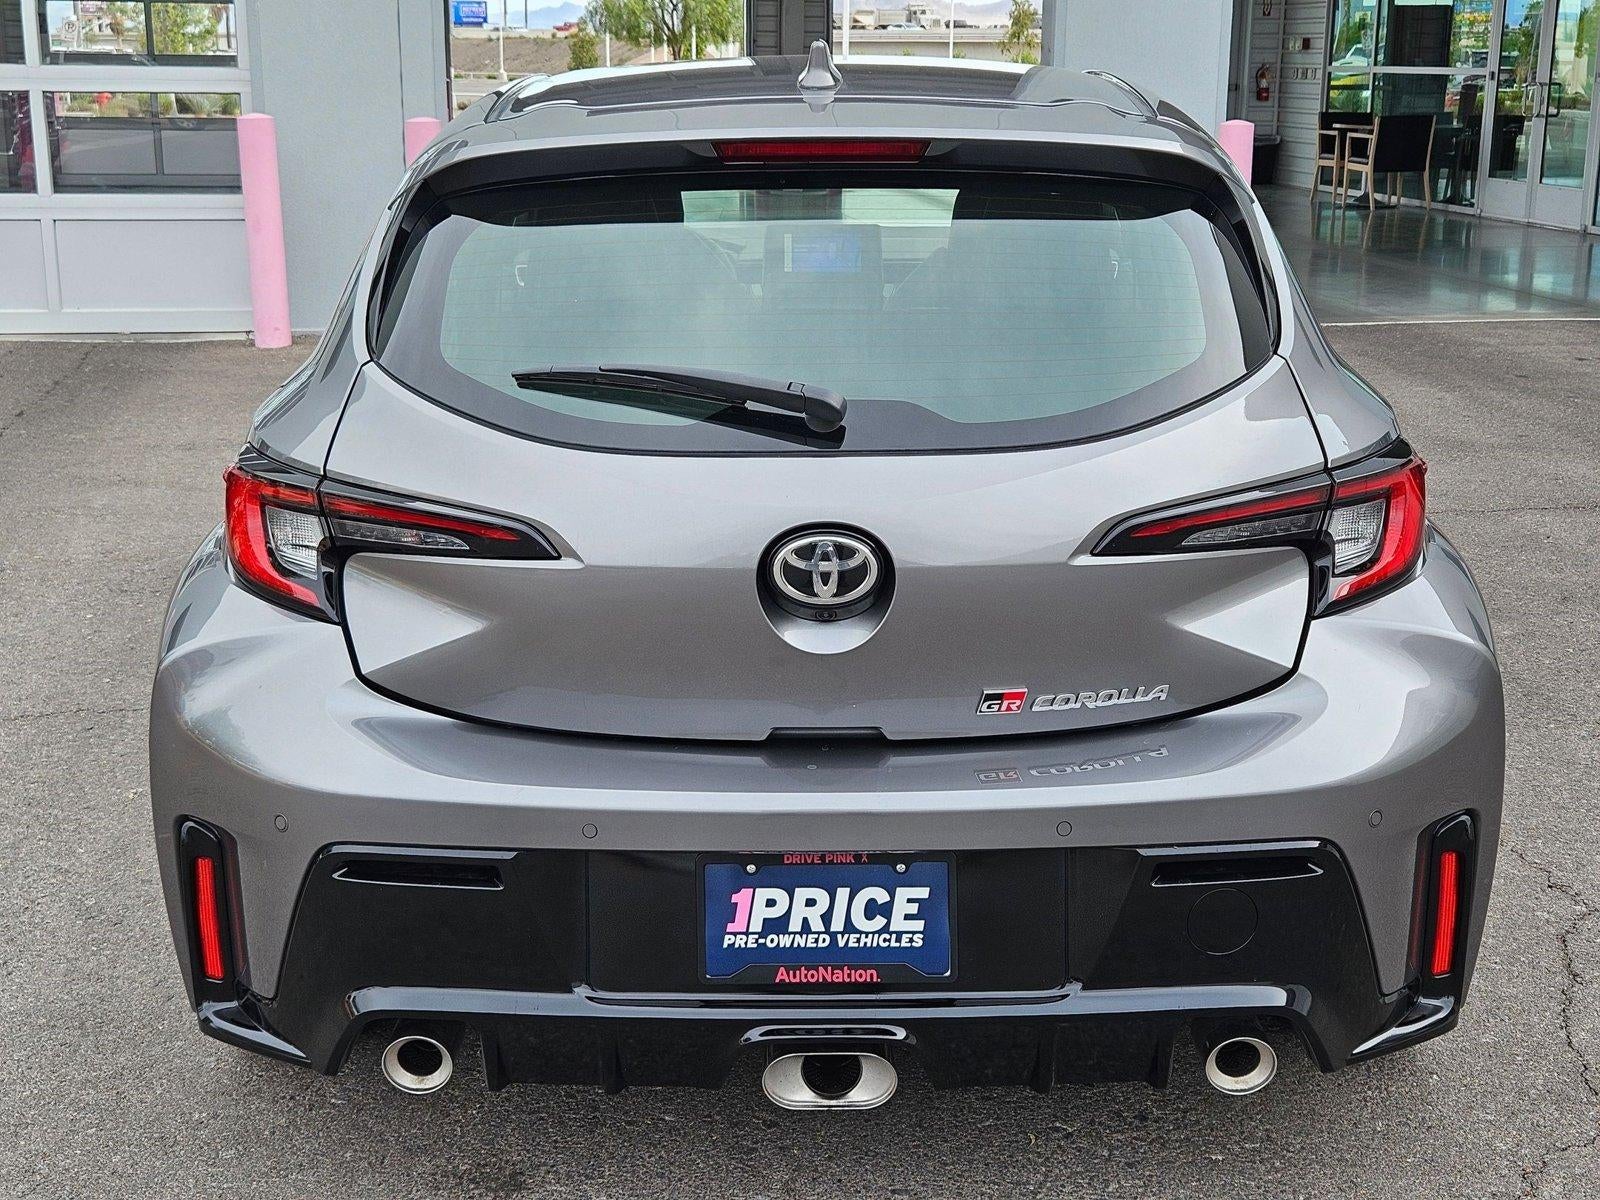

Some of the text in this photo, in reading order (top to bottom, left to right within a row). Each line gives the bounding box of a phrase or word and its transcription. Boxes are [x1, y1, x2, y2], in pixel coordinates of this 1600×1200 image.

[981, 684, 1170, 712] GR COROLLA
[783, 853, 855, 864] DRIVE PINK
[723, 934, 924, 948] PRE-OWNED VEHICLES
